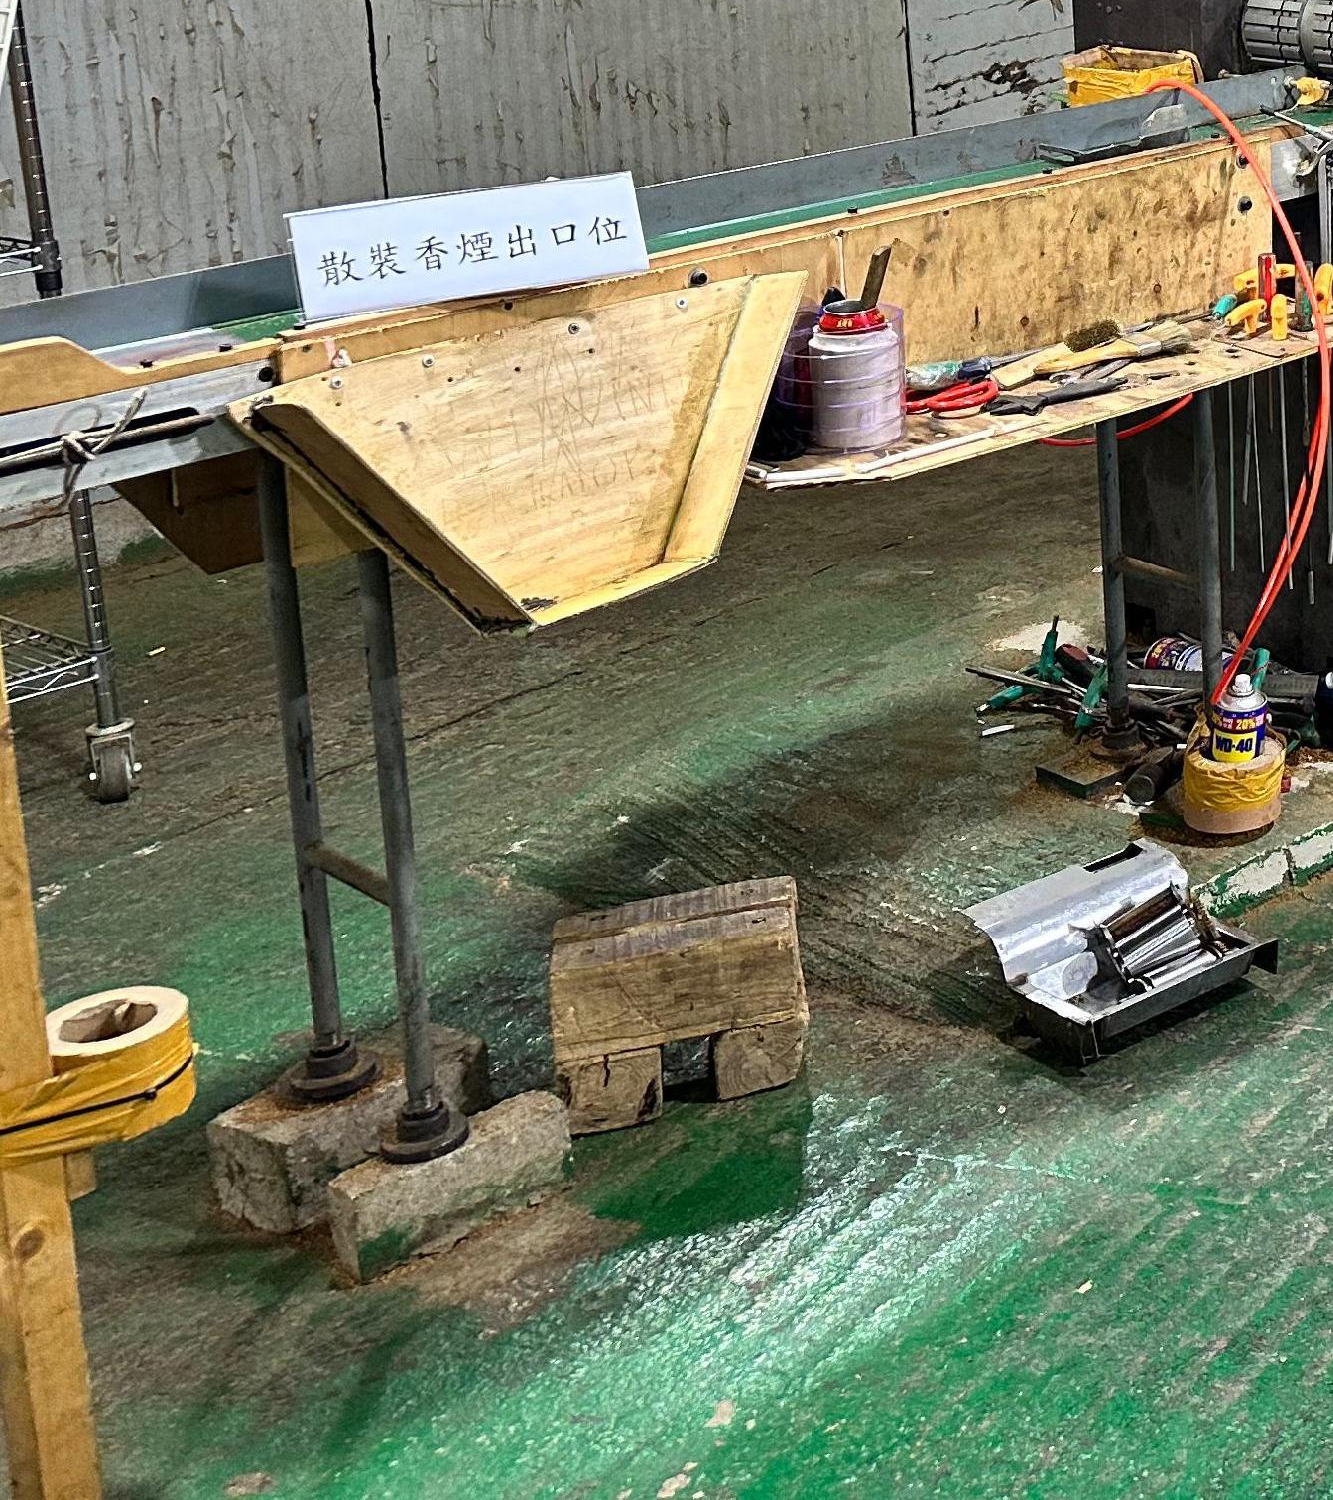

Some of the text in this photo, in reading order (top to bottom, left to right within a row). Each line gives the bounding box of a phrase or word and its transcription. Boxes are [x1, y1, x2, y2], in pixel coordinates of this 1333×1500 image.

[317, 215, 628, 288] 散裝香煙出口位
[1215, 734, 1253, 753] WD-40
